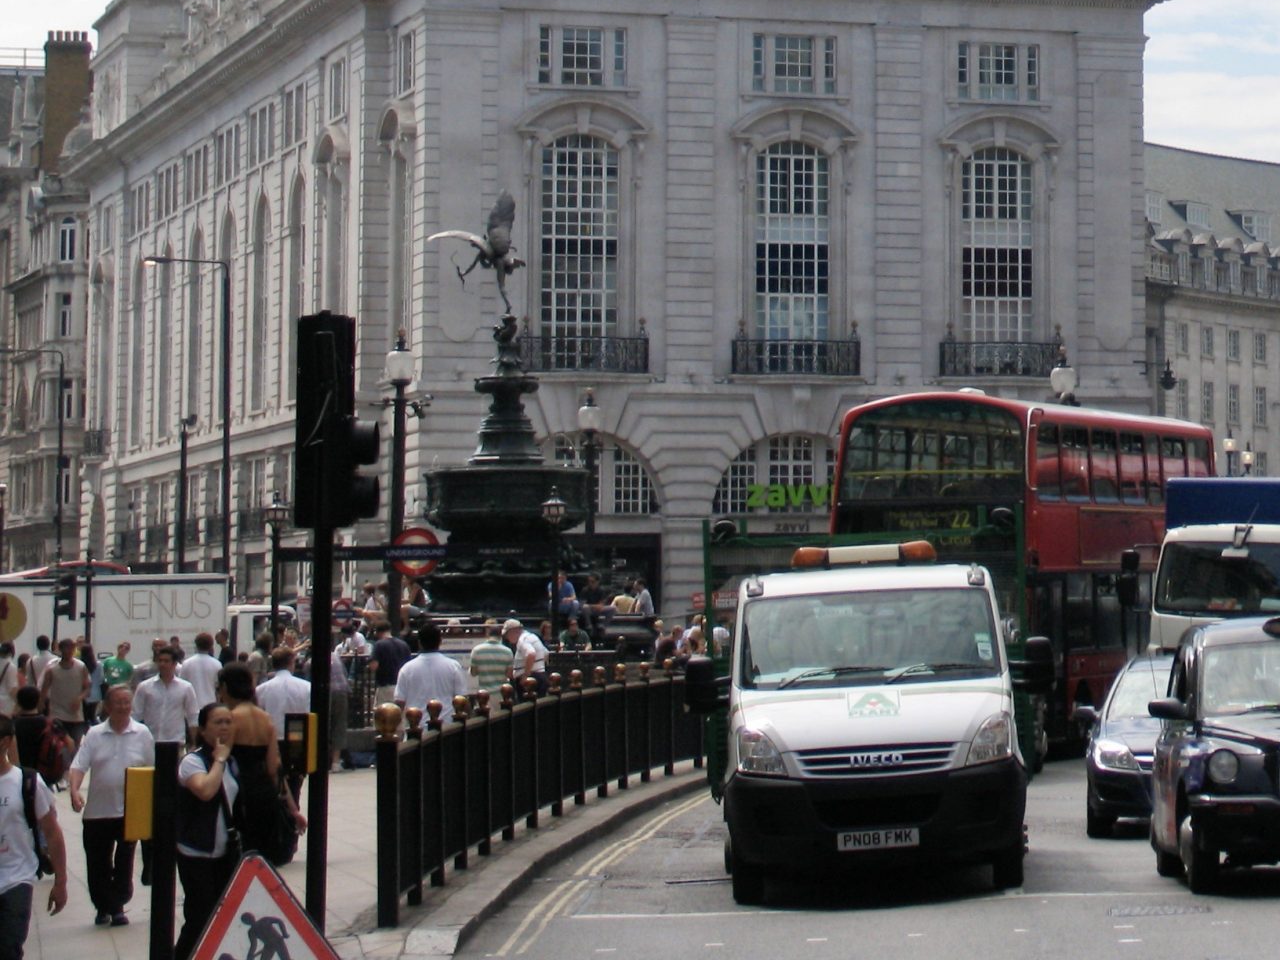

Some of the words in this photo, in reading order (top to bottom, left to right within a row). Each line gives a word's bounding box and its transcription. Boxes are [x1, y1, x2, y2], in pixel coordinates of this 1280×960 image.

[775, 521, 810, 532] zavvi
[951, 510, 971, 529] 22
[385, 548, 446, 559] UNDERGROUND
[108, 588, 212, 620] VENUS
[848, 708, 900, 718] PLANT
[849, 753, 904, 768] IVECO
[843, 832, 881, 848] PN08
[884, 829, 913, 845] FMK
